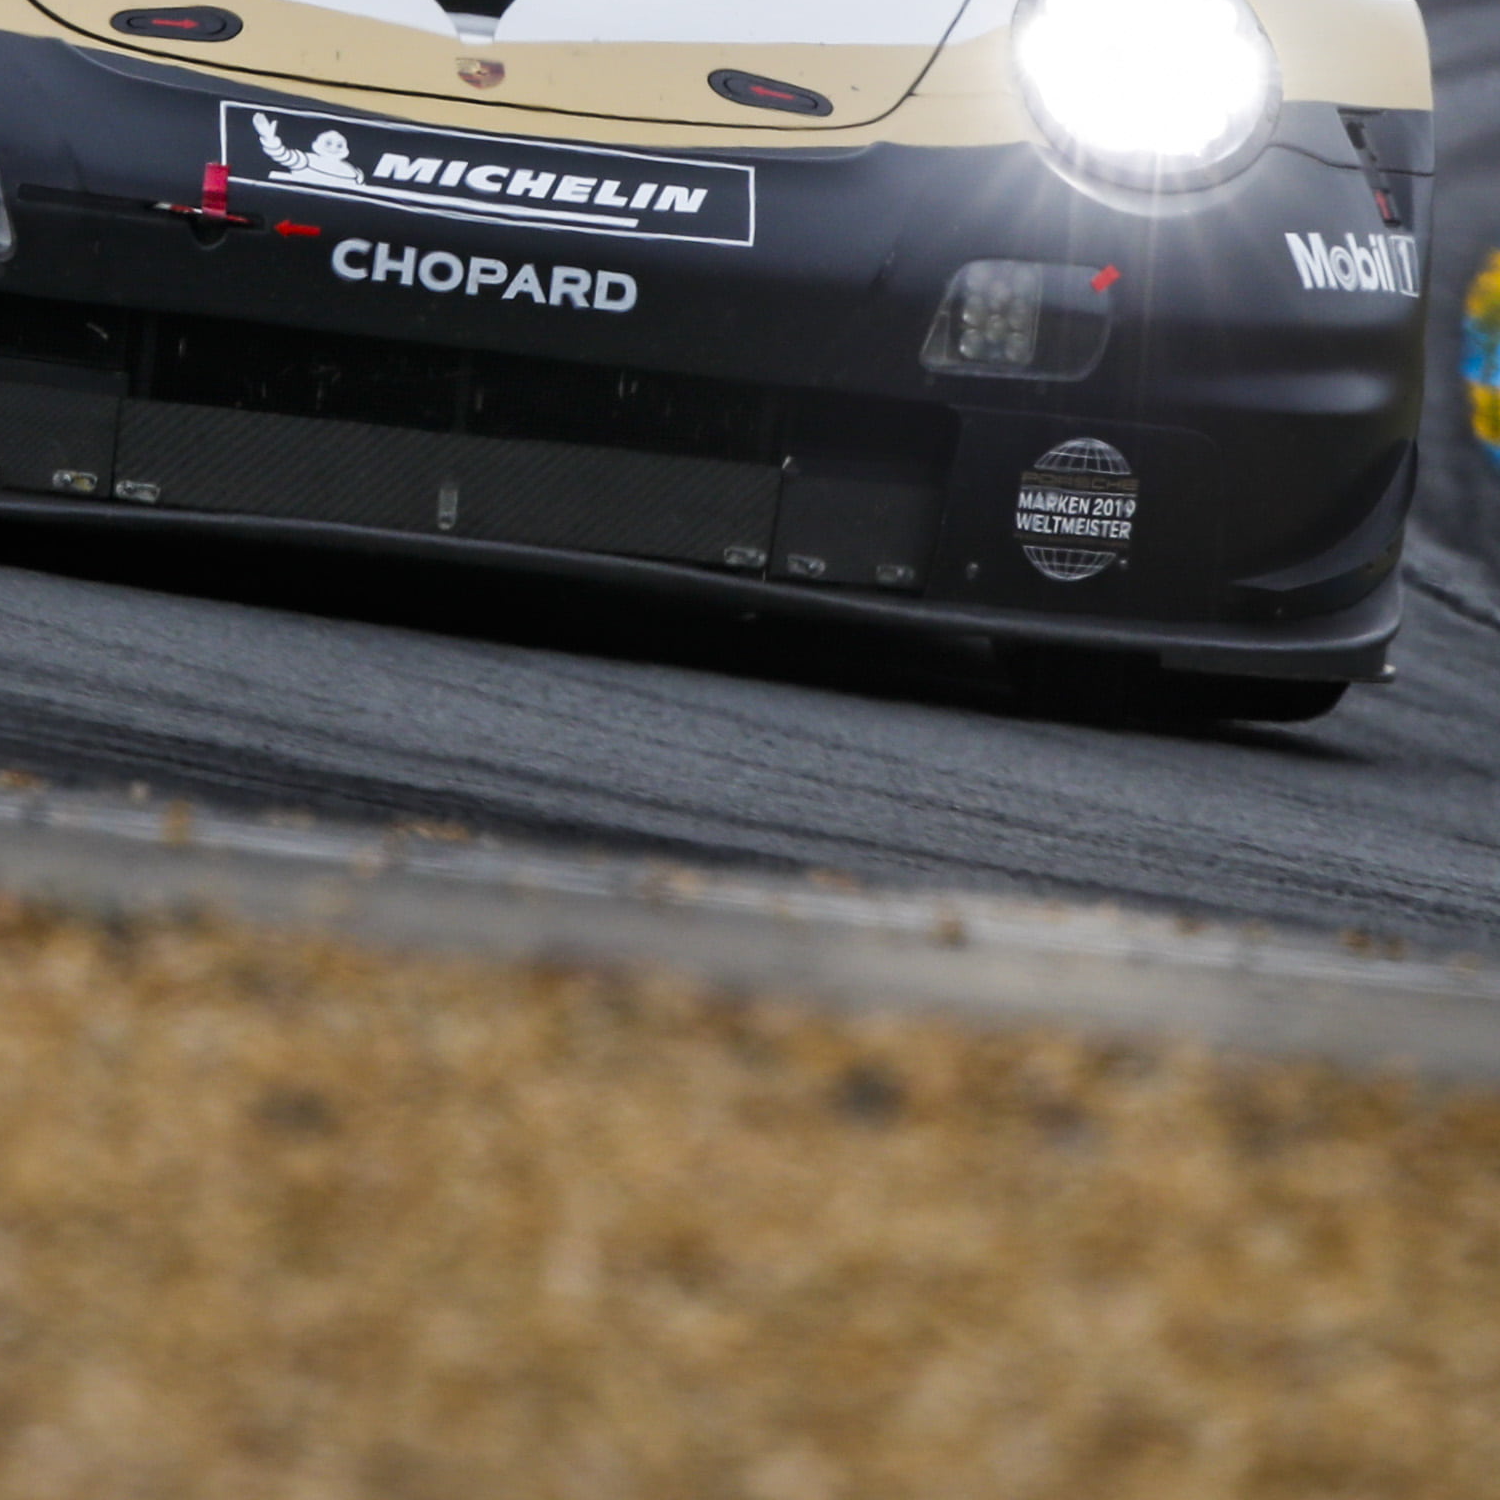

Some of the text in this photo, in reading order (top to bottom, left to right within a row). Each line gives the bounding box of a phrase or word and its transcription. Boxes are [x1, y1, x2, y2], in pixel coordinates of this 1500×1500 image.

[372, 152, 708, 215] MICHELIN
[330, 238, 638, 312] CHOPARD
[1283, 231, 1397, 293] Mobil
[1015, 511, 1133, 541] WELTMEISTER
[1017, 491, 1137, 519] MARKEN 2019
